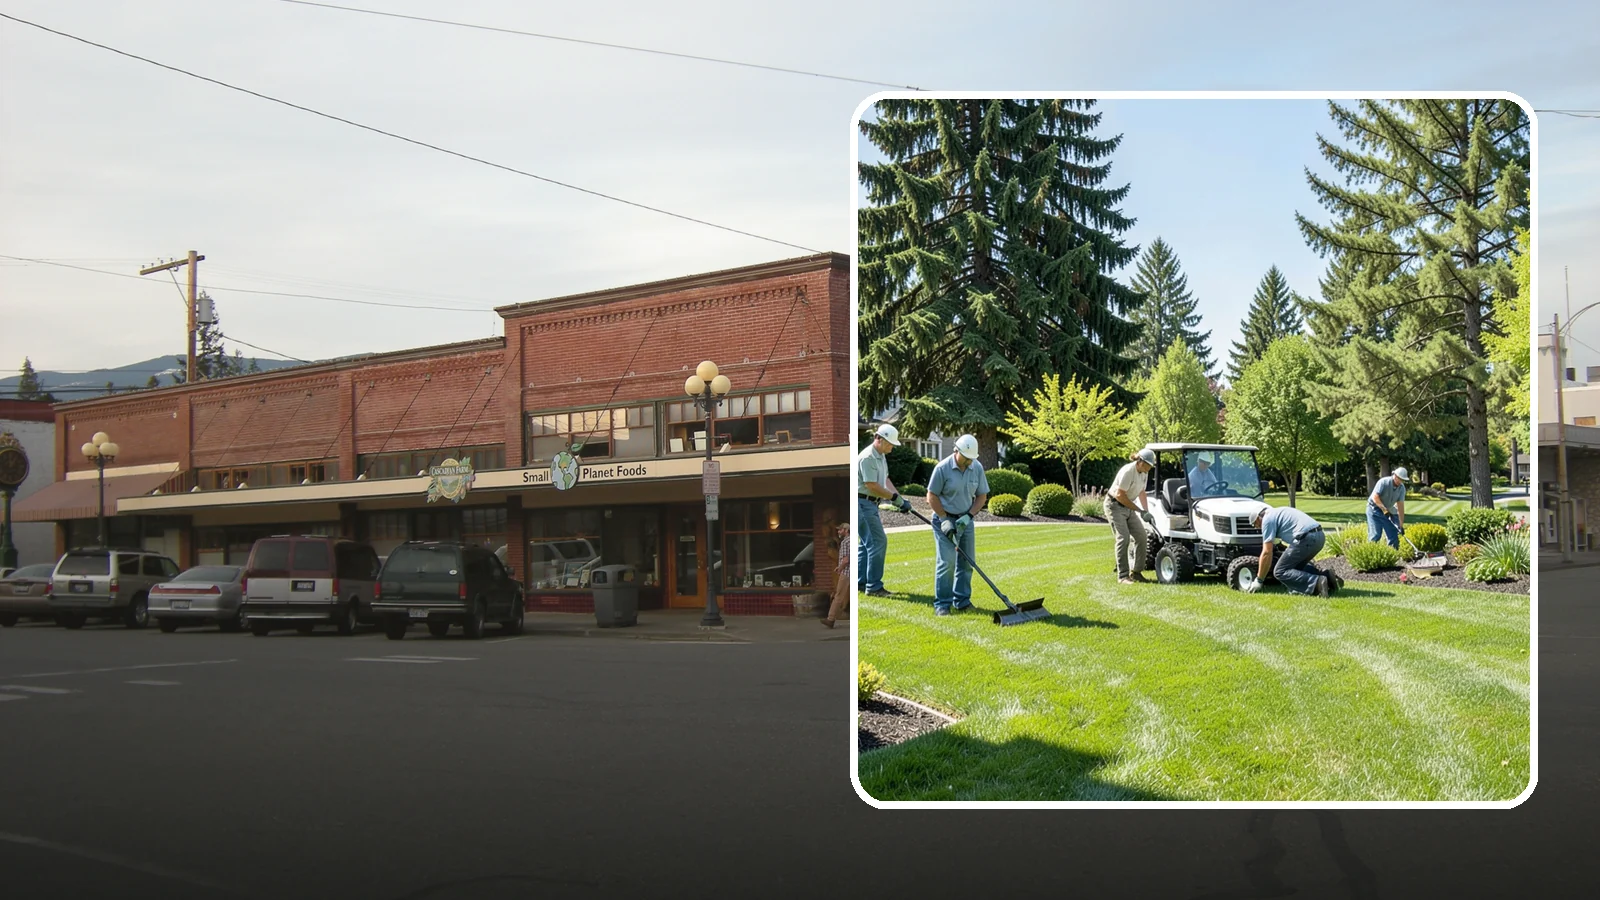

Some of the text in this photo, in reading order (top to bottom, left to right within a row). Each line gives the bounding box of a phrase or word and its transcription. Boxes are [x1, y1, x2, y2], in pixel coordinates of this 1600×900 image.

[523, 464, 646, 482] Small Planet Foods
